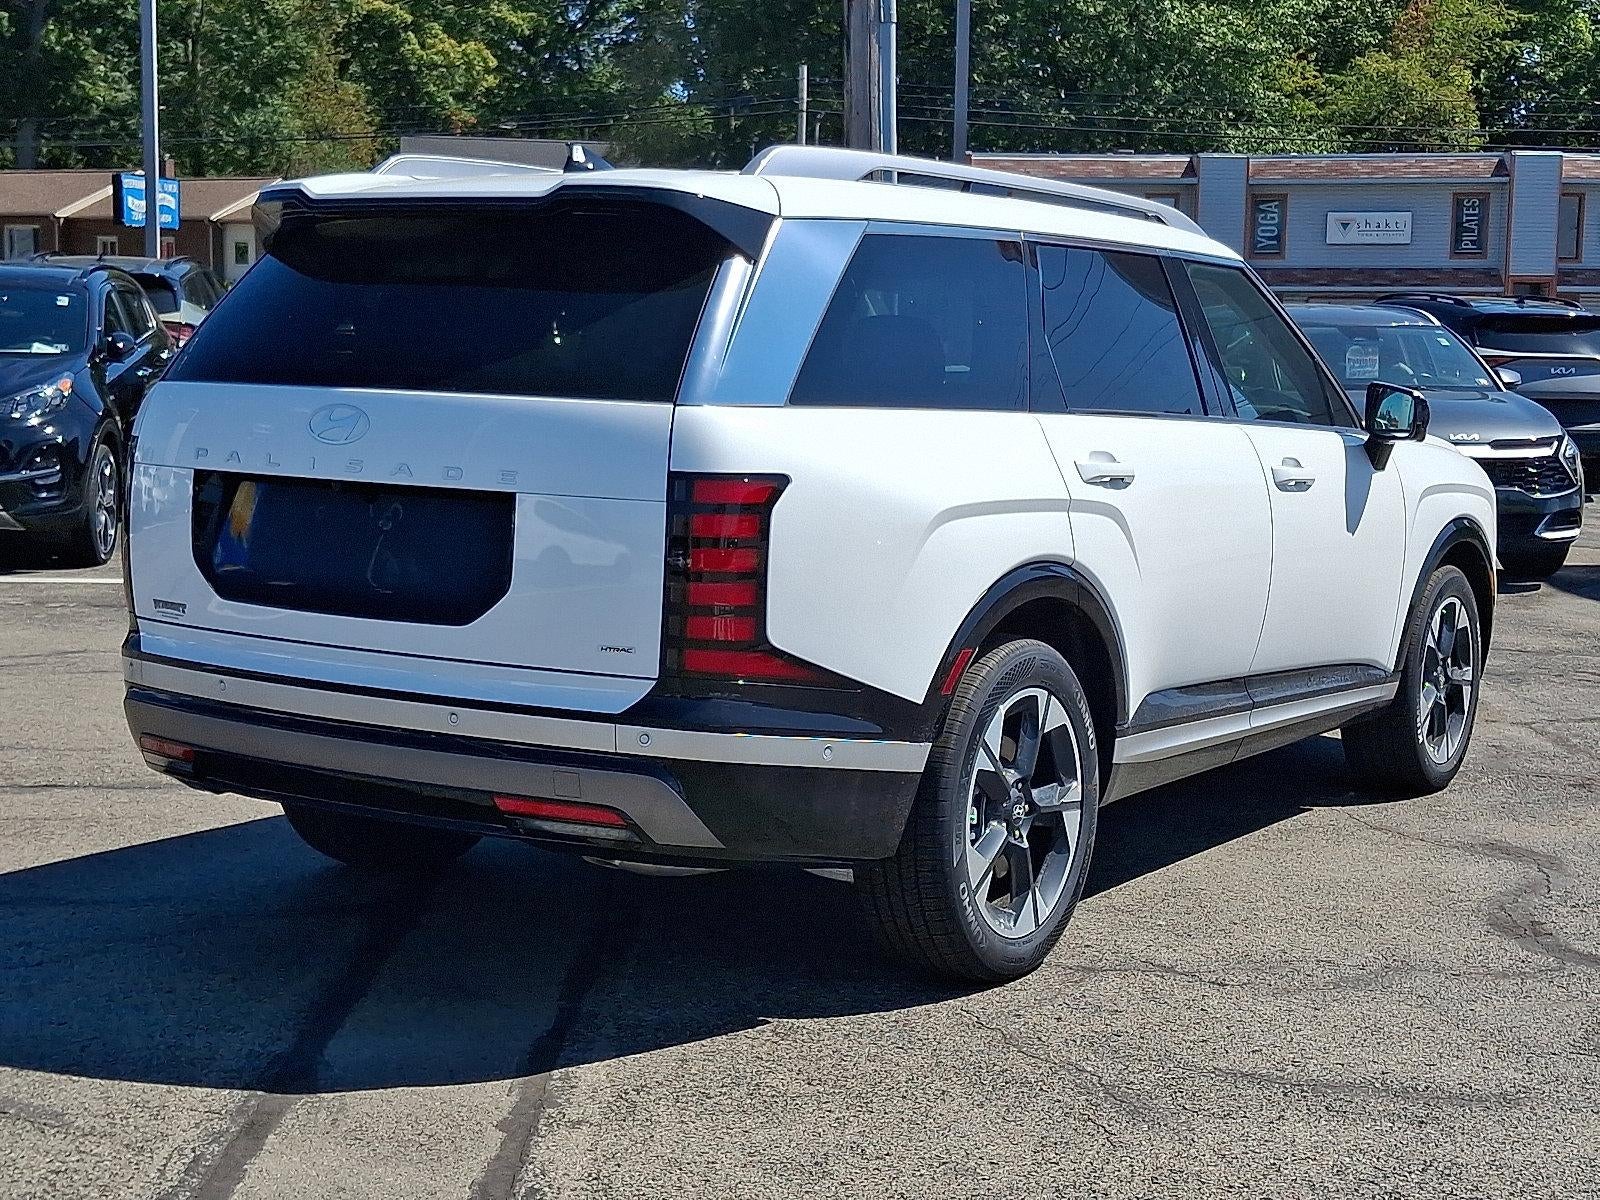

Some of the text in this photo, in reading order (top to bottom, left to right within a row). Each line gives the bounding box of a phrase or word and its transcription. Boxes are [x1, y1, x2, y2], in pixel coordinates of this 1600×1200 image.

[1256, 201, 1280, 248] YOGA
[1356, 218, 1407, 229] shakti
[1461, 198, 1479, 249] PILATES
[193, 447, 520, 486] PALISADE
[600, 646, 633, 654] HTRAC
